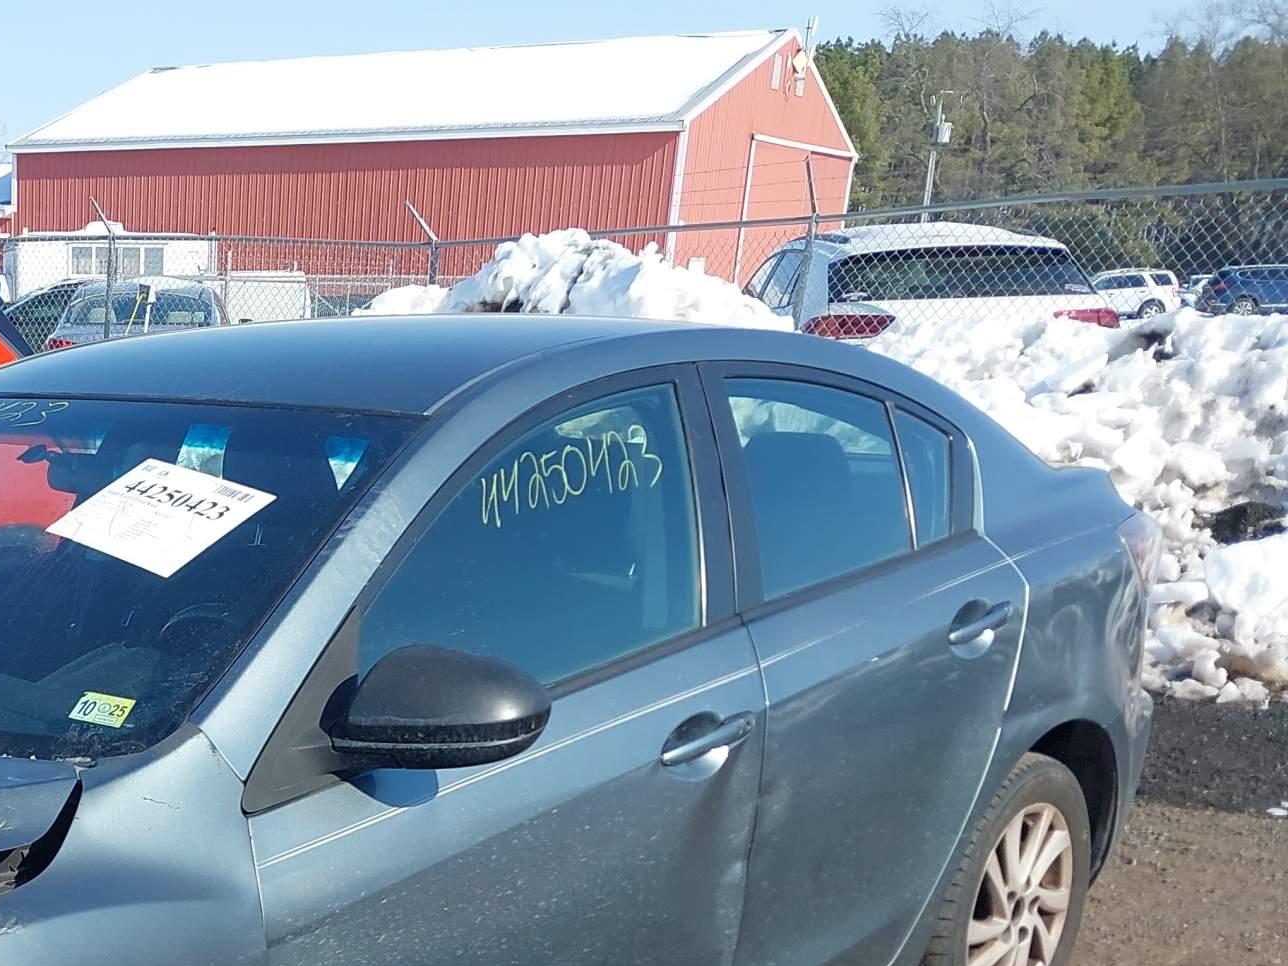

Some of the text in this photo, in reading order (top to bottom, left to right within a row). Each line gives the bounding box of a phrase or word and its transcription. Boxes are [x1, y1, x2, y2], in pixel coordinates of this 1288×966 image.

[480, 424, 663, 528] 44250423
[124, 479, 231, 521] 44250423
[77, 699, 128, 718] 10 25
